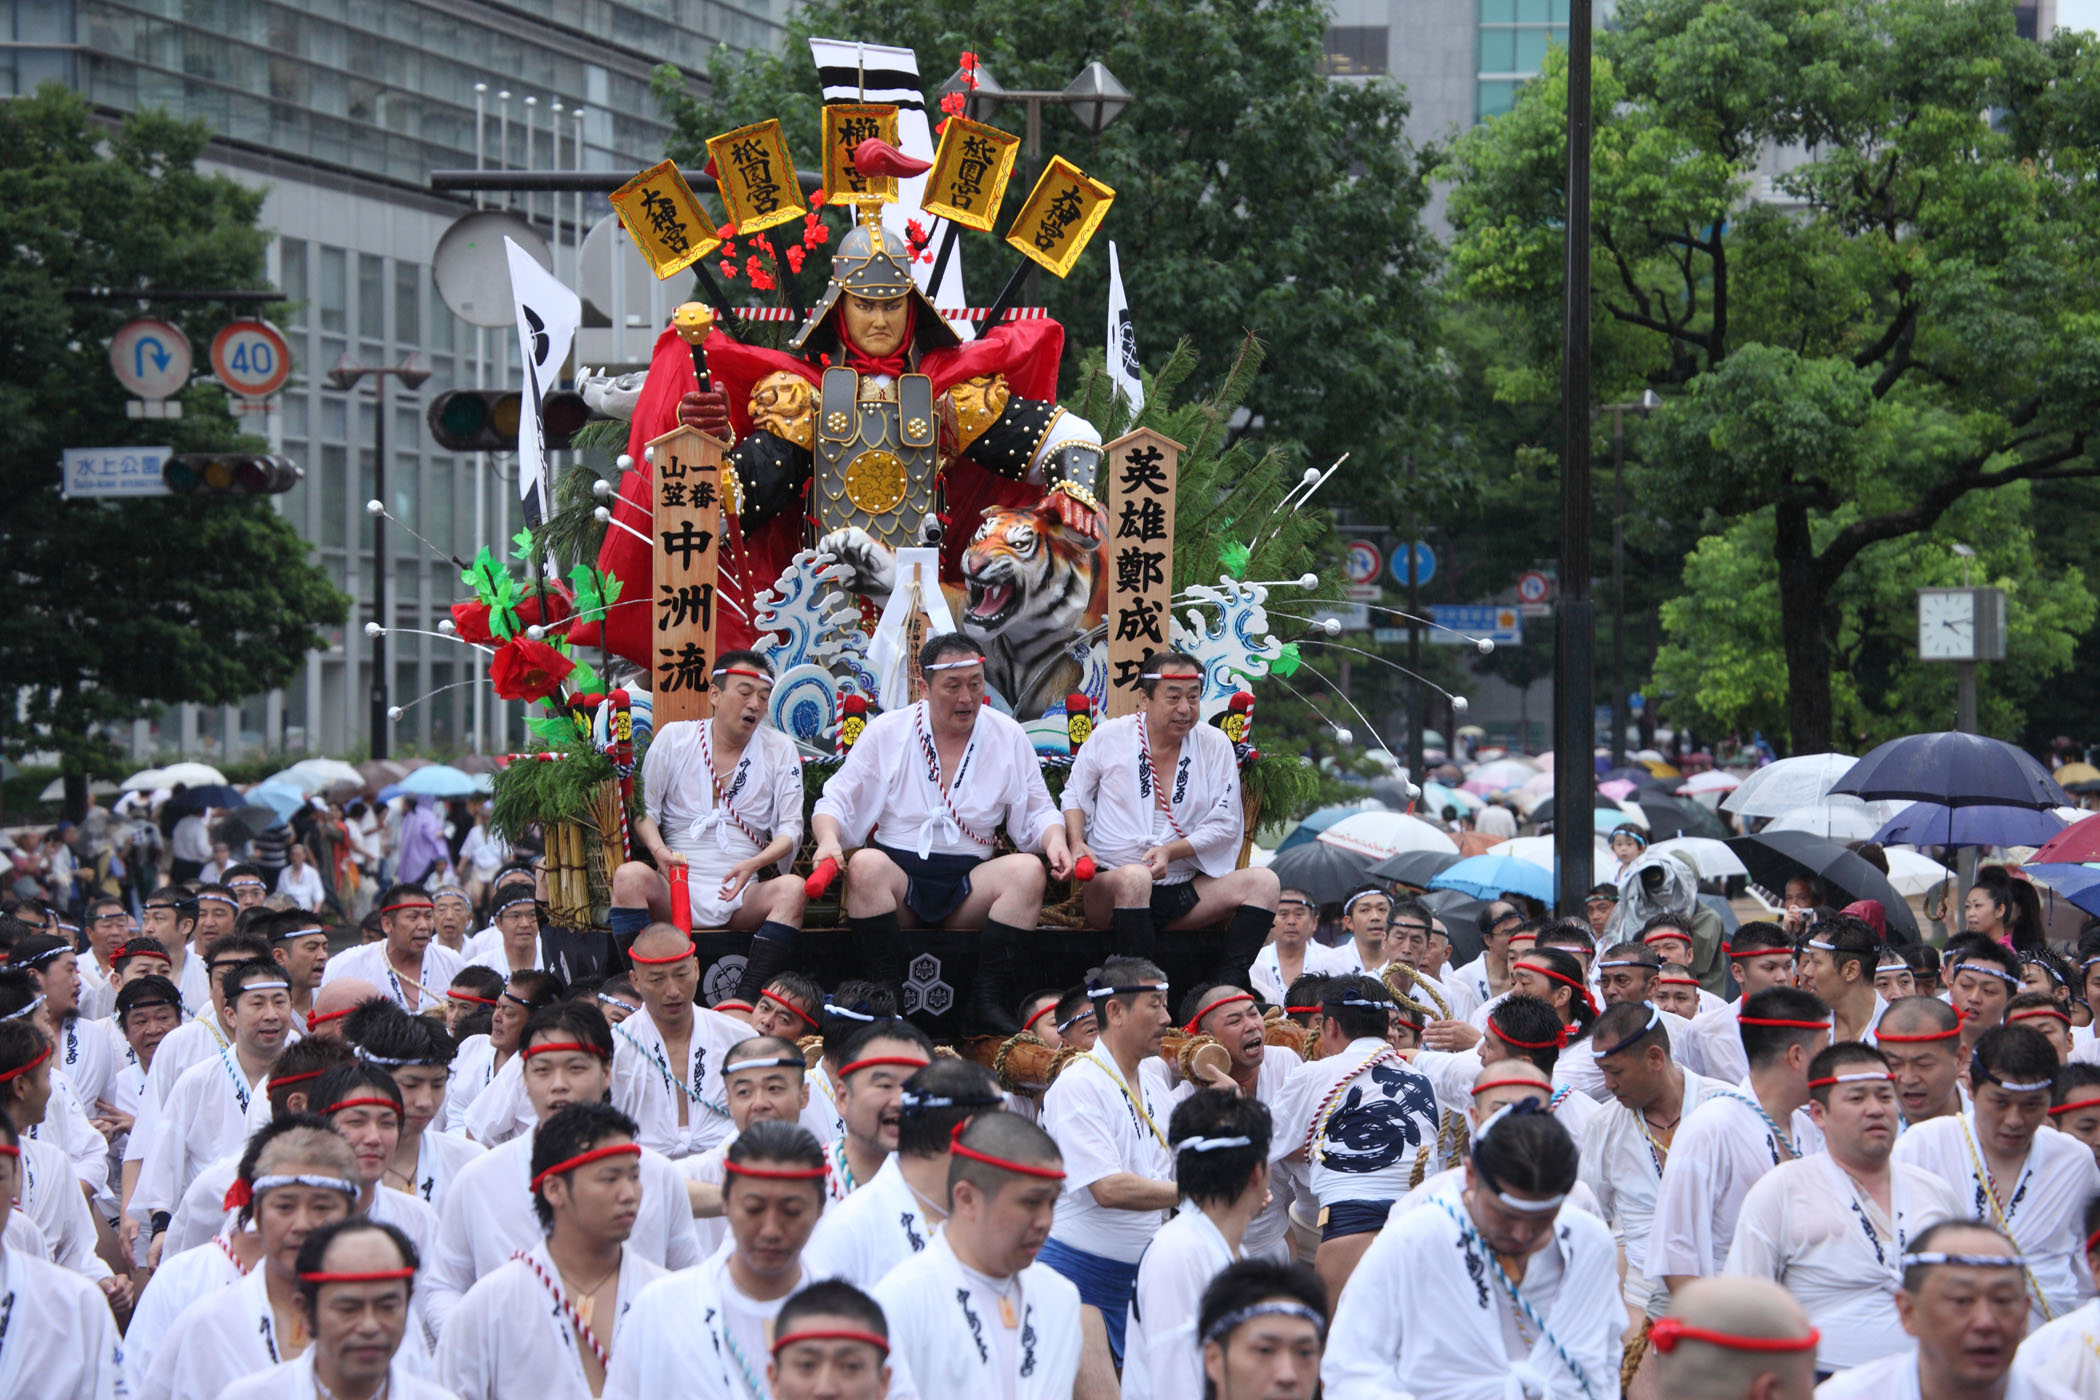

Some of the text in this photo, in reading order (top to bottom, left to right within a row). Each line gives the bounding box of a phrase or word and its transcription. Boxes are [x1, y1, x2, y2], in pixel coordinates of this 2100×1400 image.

[640, 187, 689, 254] 大神宮
[1034, 185, 1083, 252] 大神宮
[231, 341, 272, 374] 40
[76, 455, 160, 476] 水上公園
[657, 520, 714, 692] 中洲流
